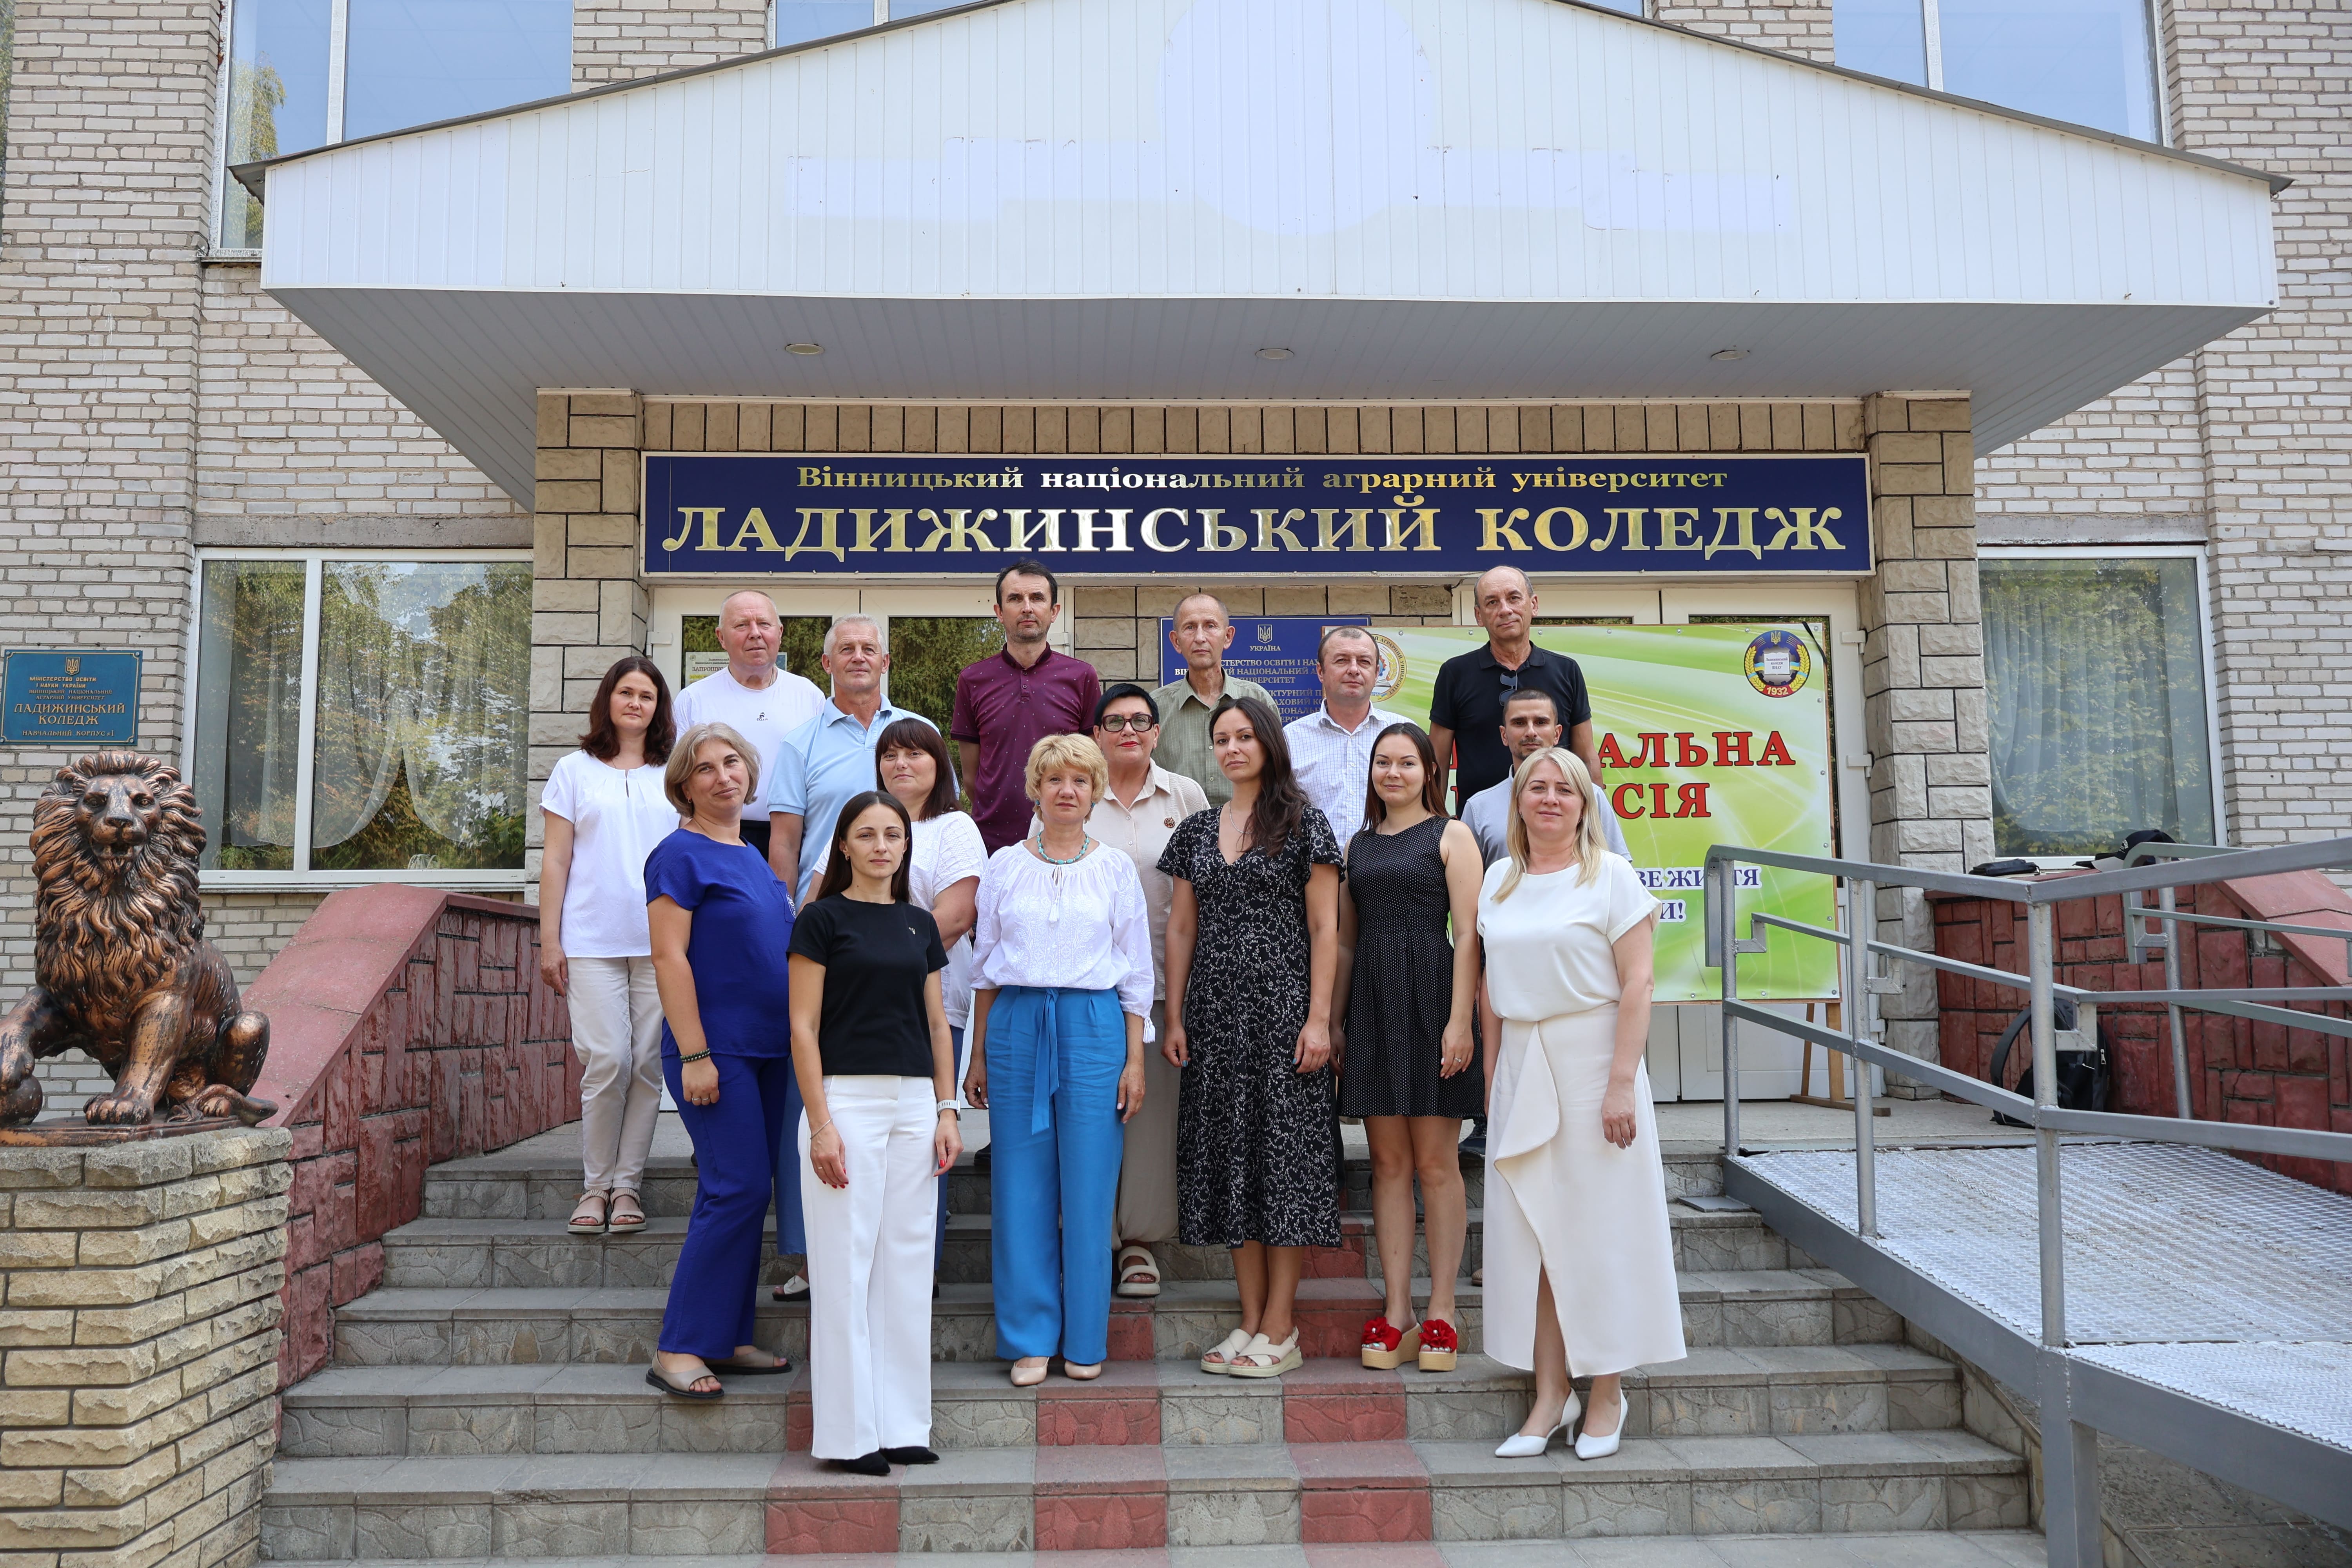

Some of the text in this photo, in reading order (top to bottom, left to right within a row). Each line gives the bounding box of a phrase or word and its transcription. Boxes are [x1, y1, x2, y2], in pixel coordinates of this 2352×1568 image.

[797, 465, 1728, 494] Вінницький національний аграрний університет
[662, 495, 1846, 563] ЛАДИЖИНСЬКИЙ КОЛЕДЖ
[1237, 666, 1308, 676] НАЦІОНАЛЬНИЙ
[1766, 687, 1789, 696] 1932
[14, 703, 125, 714] ЛАДИЖИНСЬКИЙ
[38, 715, 99, 726] КОЛЕДЖ
